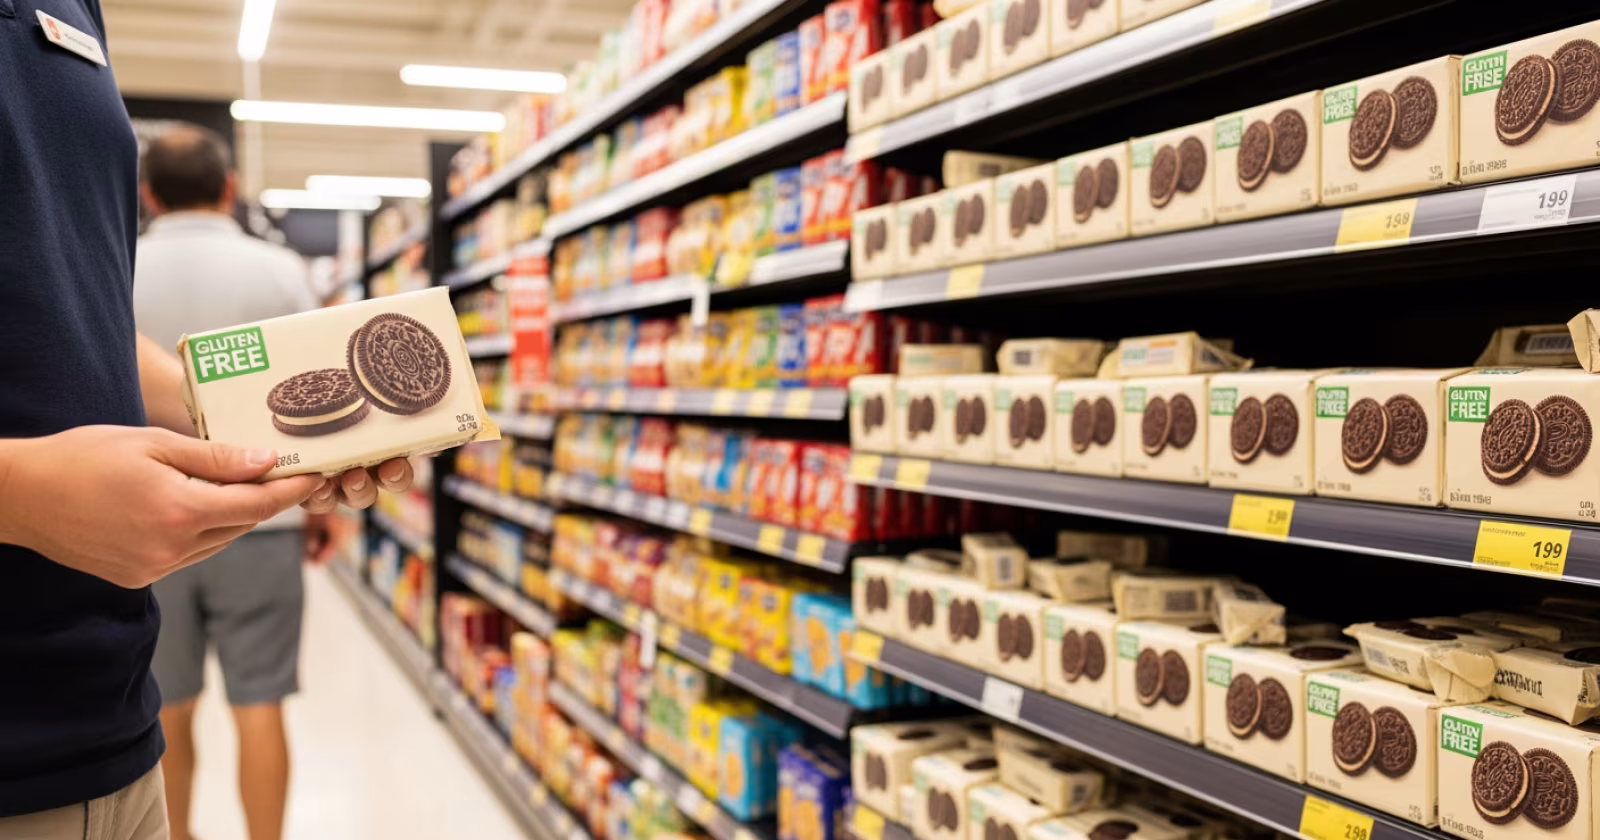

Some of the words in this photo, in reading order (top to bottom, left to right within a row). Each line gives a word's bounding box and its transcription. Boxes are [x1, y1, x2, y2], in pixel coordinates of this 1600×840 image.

[1538, 189, 1568, 209] 199
[195, 331, 260, 354] GLUTEN
[198, 345, 265, 378] FREE
[1450, 401, 1487, 419] FREE
[1533, 541, 1562, 558] 199
[1443, 728, 1479, 756] FREE
